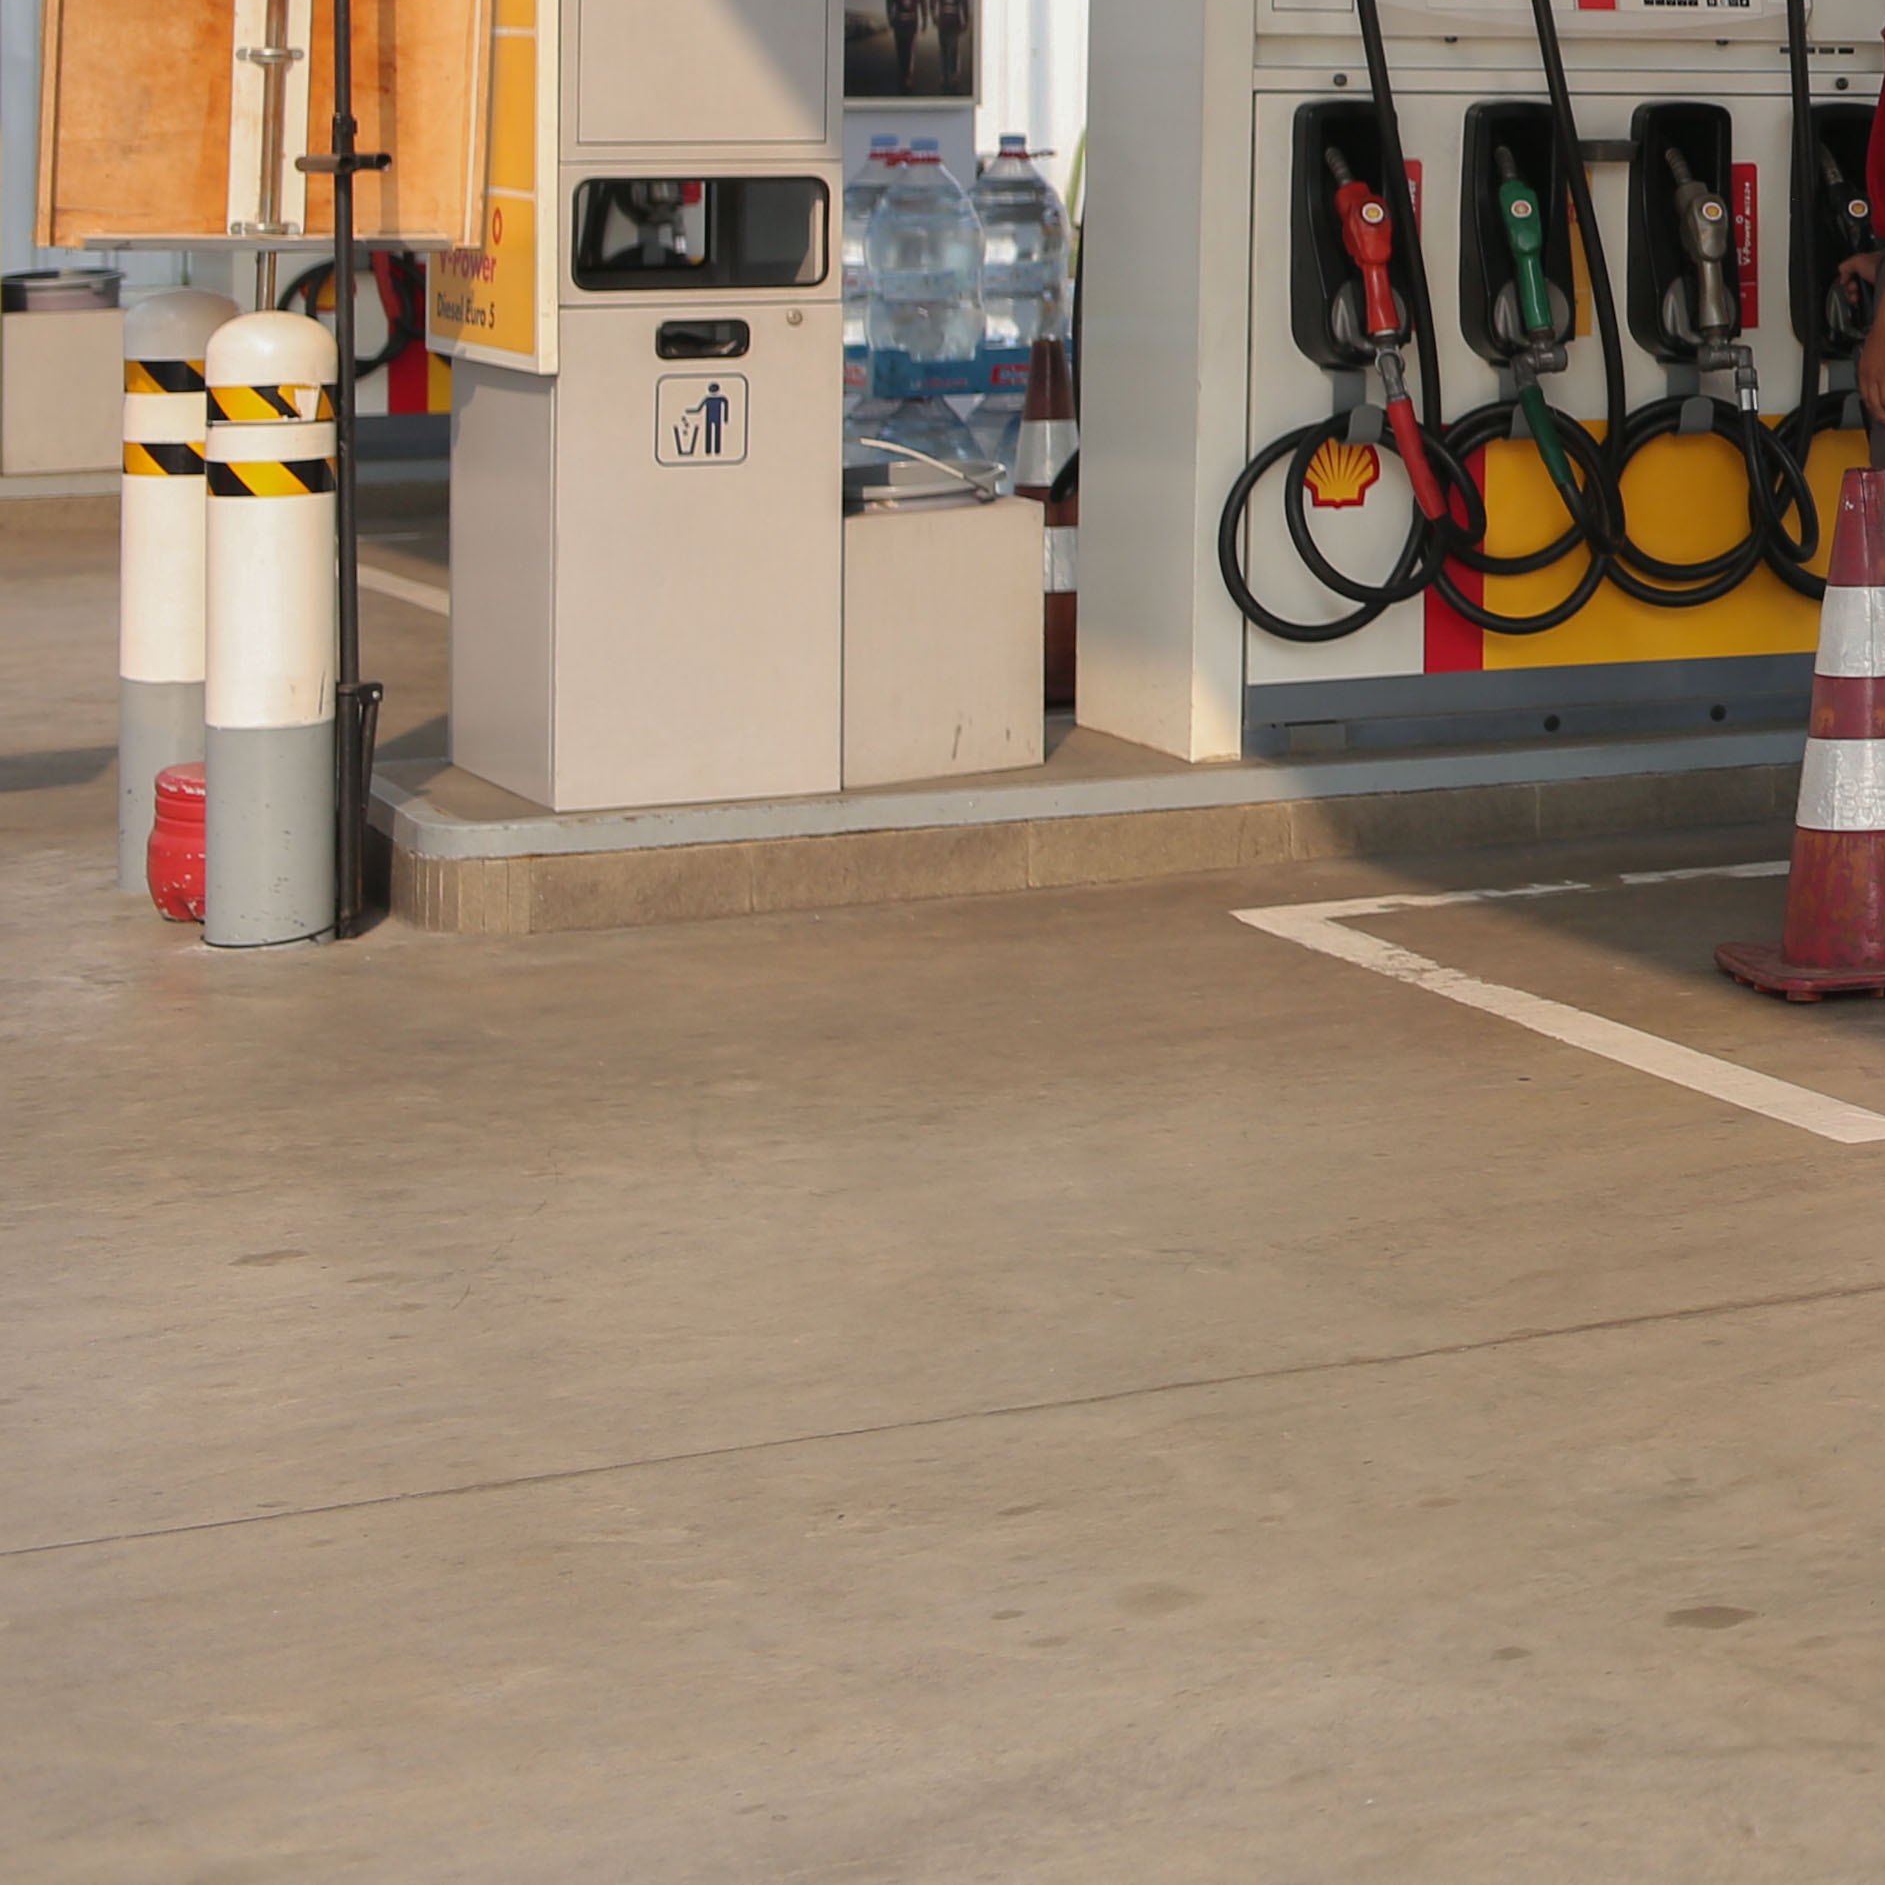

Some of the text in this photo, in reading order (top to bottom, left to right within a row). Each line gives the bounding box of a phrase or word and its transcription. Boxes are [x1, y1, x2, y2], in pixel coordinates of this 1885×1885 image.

[437, 292, 495, 329] Diesel Euro 5
